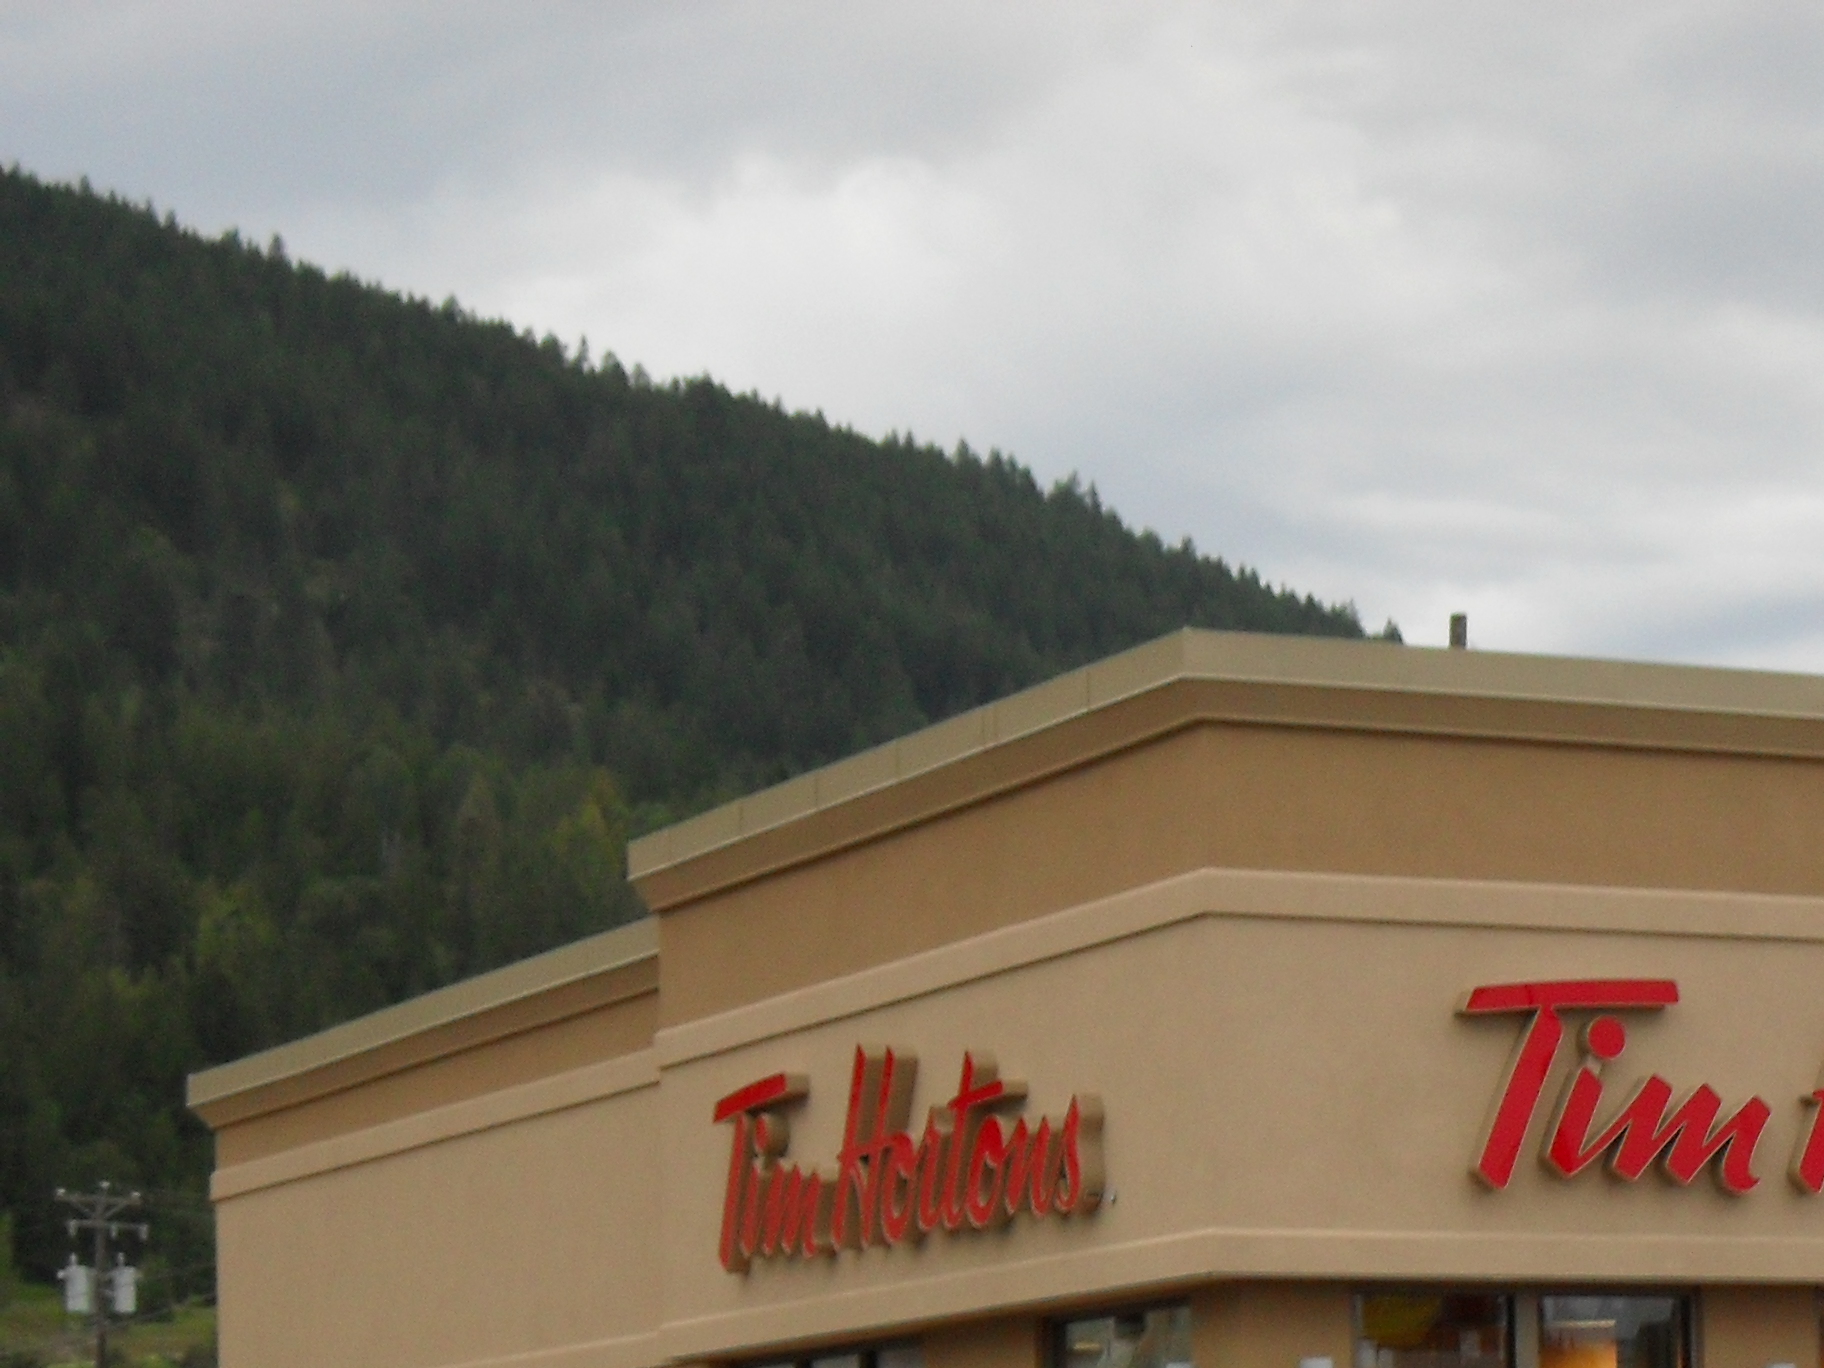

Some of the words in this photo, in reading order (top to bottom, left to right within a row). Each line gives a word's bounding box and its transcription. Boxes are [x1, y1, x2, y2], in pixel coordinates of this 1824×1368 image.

[713, 1072, 824, 1268] Tim
[831, 1043, 1084, 1244] Hortons
[1465, 978, 1771, 1193] Tim
